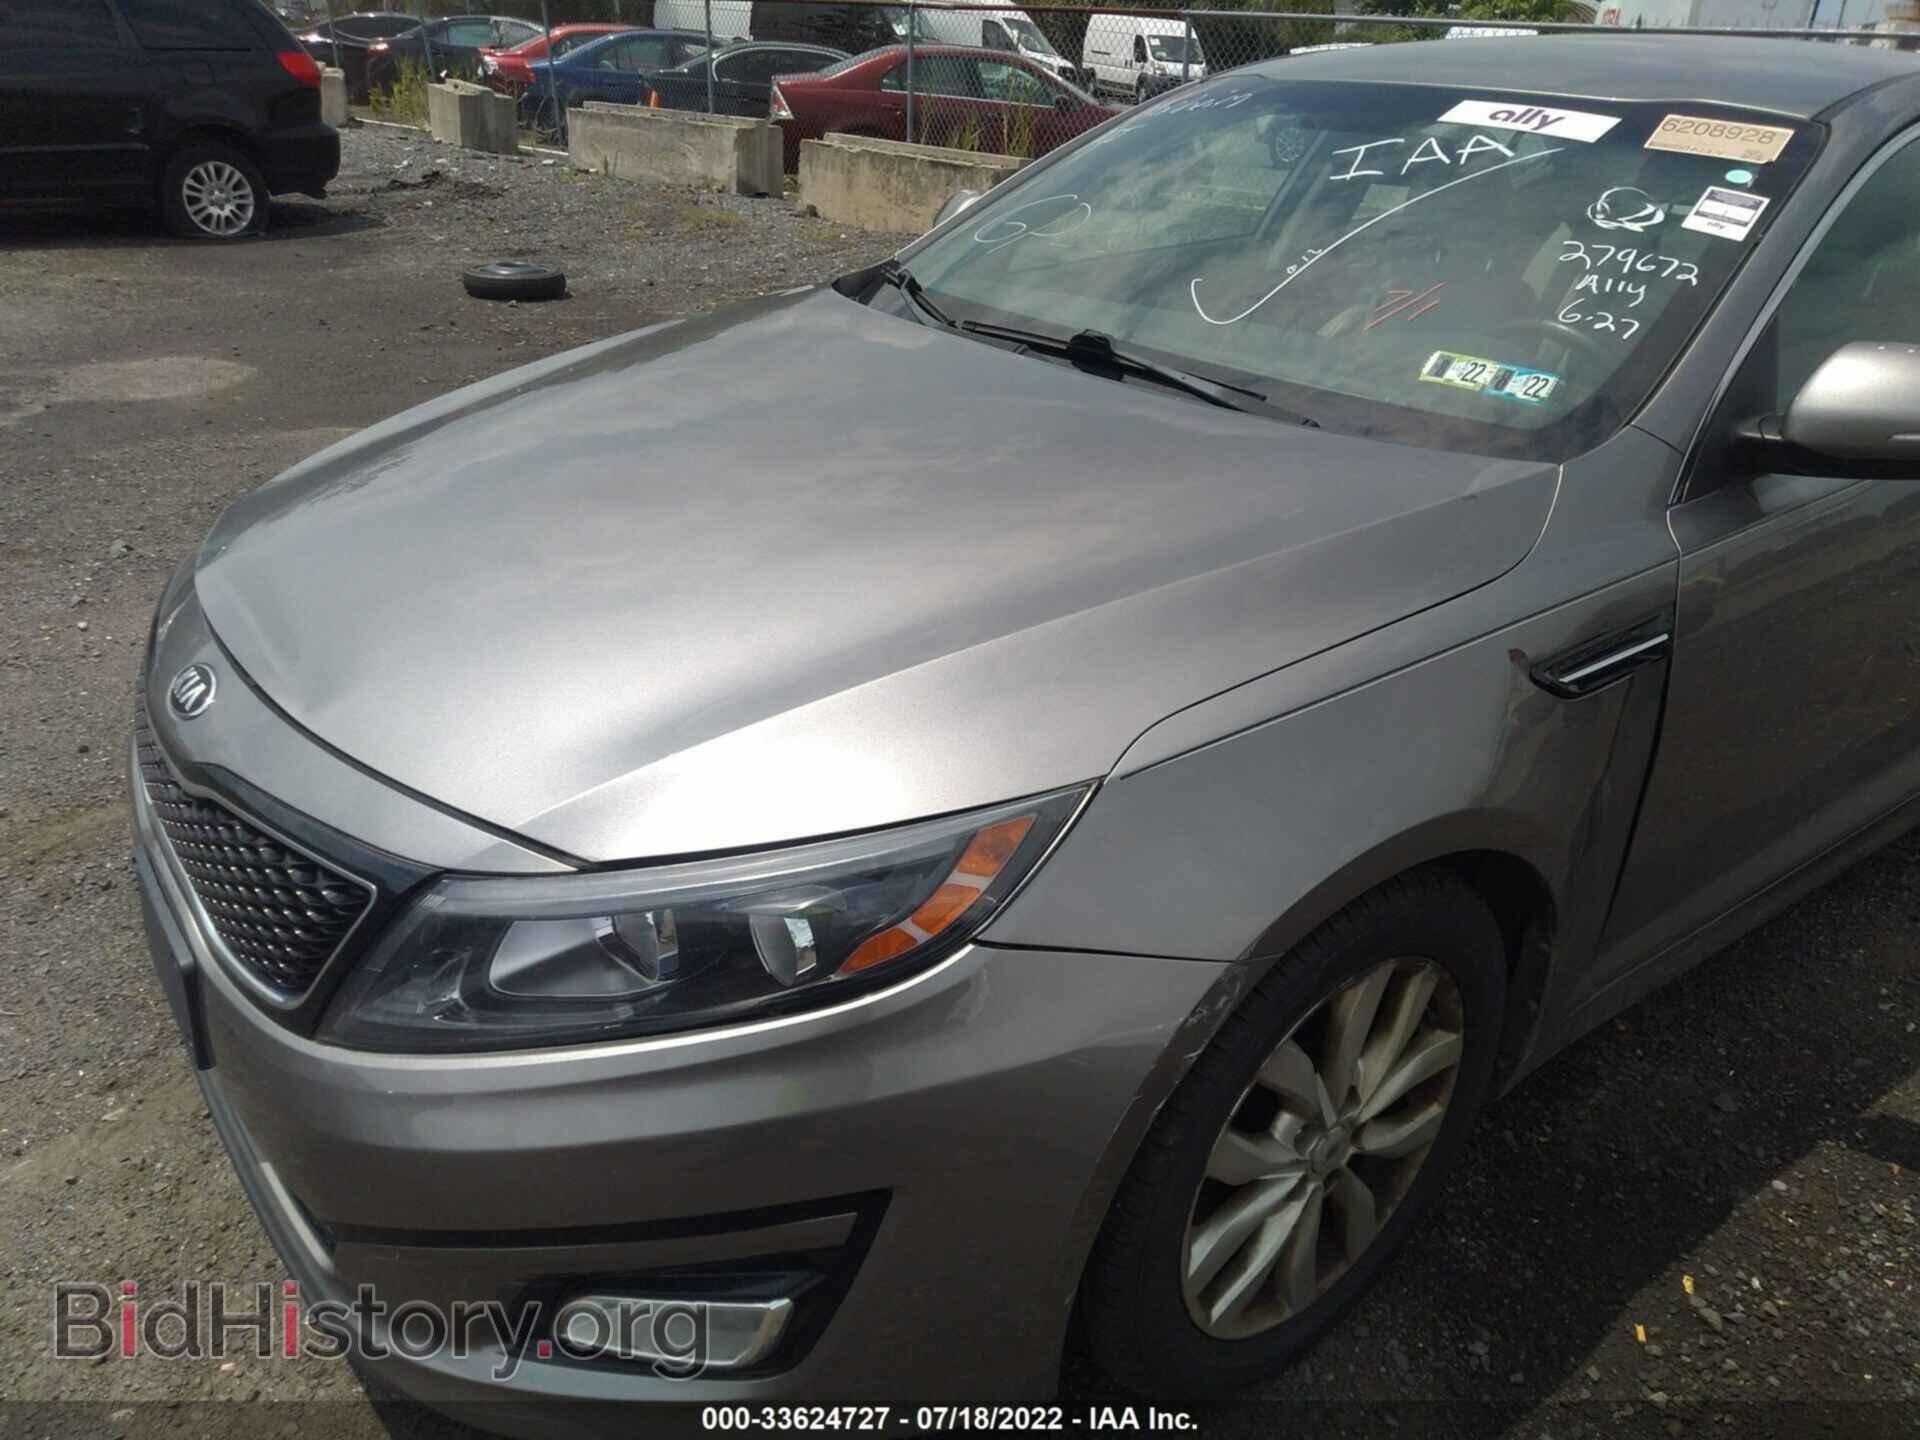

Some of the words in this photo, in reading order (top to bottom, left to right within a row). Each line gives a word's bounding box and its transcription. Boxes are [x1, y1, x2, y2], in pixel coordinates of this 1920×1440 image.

[1489, 107, 1566, 130] ally
[1661, 118, 1777, 145] 6208928
[1329, 135, 1516, 180] IAA
[1559, 240, 1699, 287] 279672
[1558, 298, 1640, 340] 6-27
[1460, 361, 1488, 384] 22
[1522, 375, 1550, 399] 22
